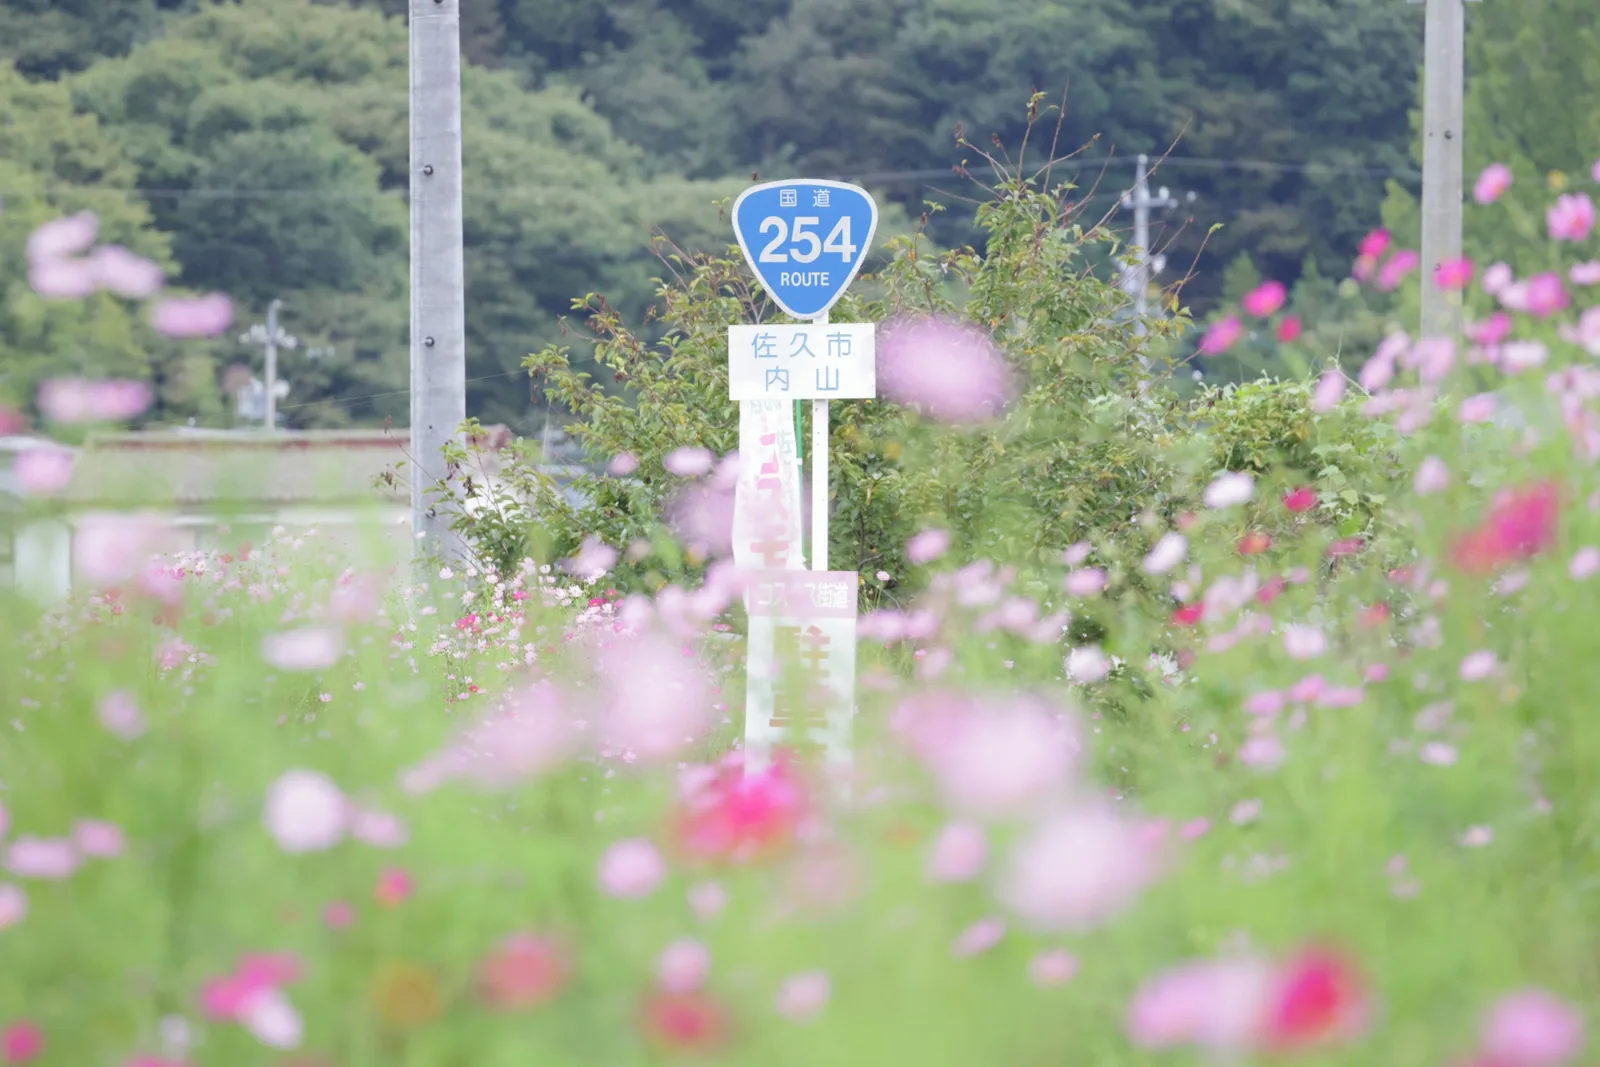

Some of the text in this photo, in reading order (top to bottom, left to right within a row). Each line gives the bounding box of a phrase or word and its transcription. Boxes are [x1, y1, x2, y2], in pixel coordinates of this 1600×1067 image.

[779, 188, 831, 208] 国道
[758, 215, 857, 264] 254
[780, 271, 830, 287] ROUTE
[751, 331, 853, 359] 佐久市
[765, 365, 840, 392] 内山
